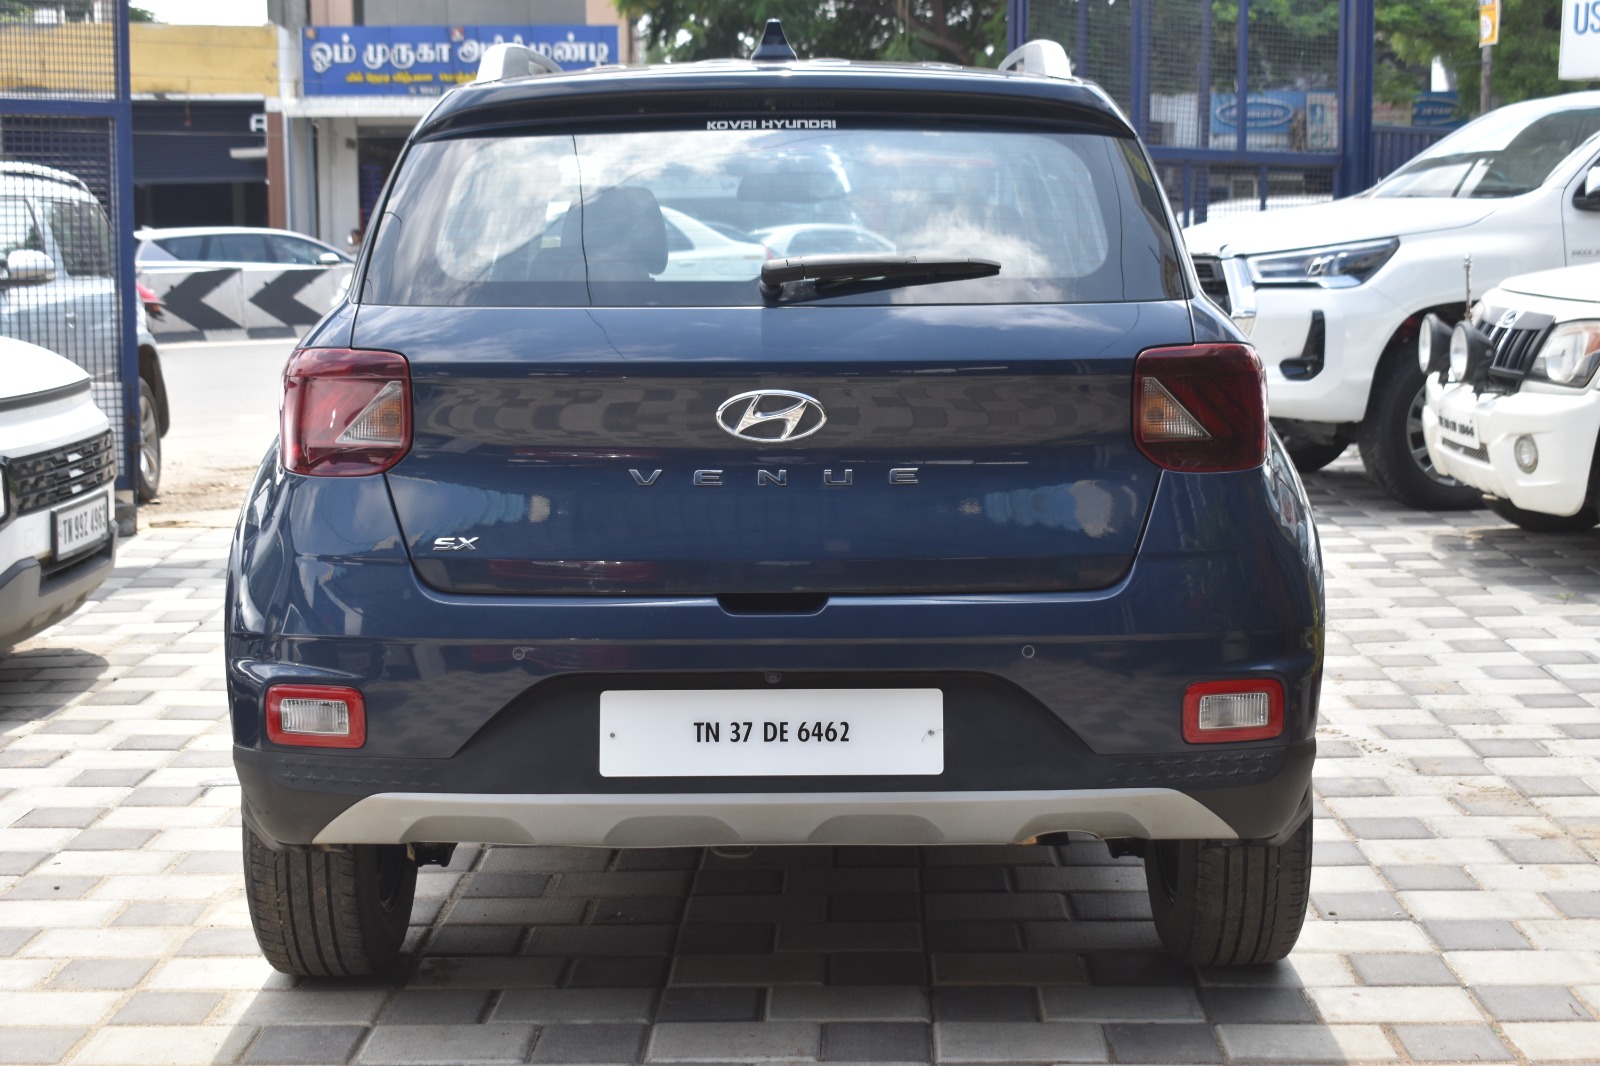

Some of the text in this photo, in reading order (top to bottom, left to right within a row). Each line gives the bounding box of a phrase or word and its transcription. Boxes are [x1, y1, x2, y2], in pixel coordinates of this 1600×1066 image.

[310, 33, 357, 73] ஓம்
[362, 43, 451, 70] முருகா
[706, 119, 837, 130] KOVAI HYUNDAI
[629, 467, 919, 486] VENUE
[433, 536, 480, 551] SX
[693, 722, 850, 742] TN 37 DE 6462
